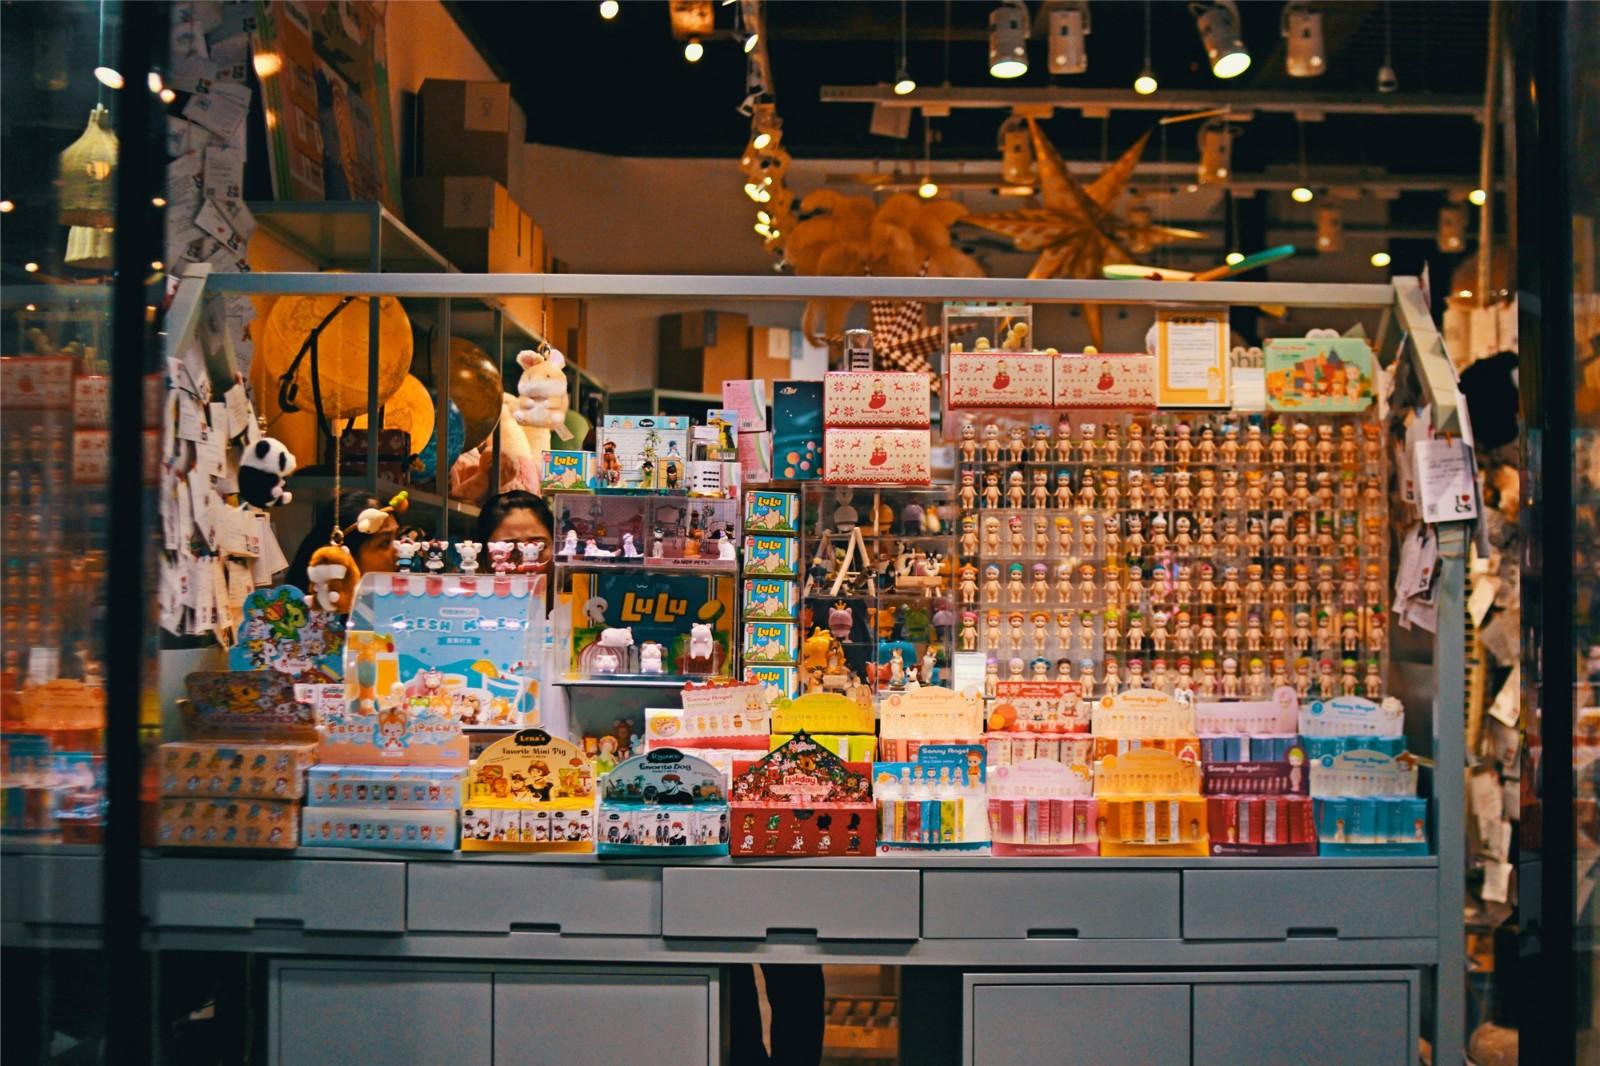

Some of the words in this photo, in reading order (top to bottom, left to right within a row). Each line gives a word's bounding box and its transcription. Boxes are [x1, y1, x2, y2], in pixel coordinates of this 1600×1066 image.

[553, 456, 578, 466] LuLu
[757, 496, 782, 507] LuLu
[757, 540, 782, 550] LuLu
[756, 584, 780, 594] LuLu
[621, 592, 688, 622] LuLu
[757, 627, 781, 637] LuLu
[673, 762, 692, 772] Dog
[784, 775, 816, 785] Holiday
